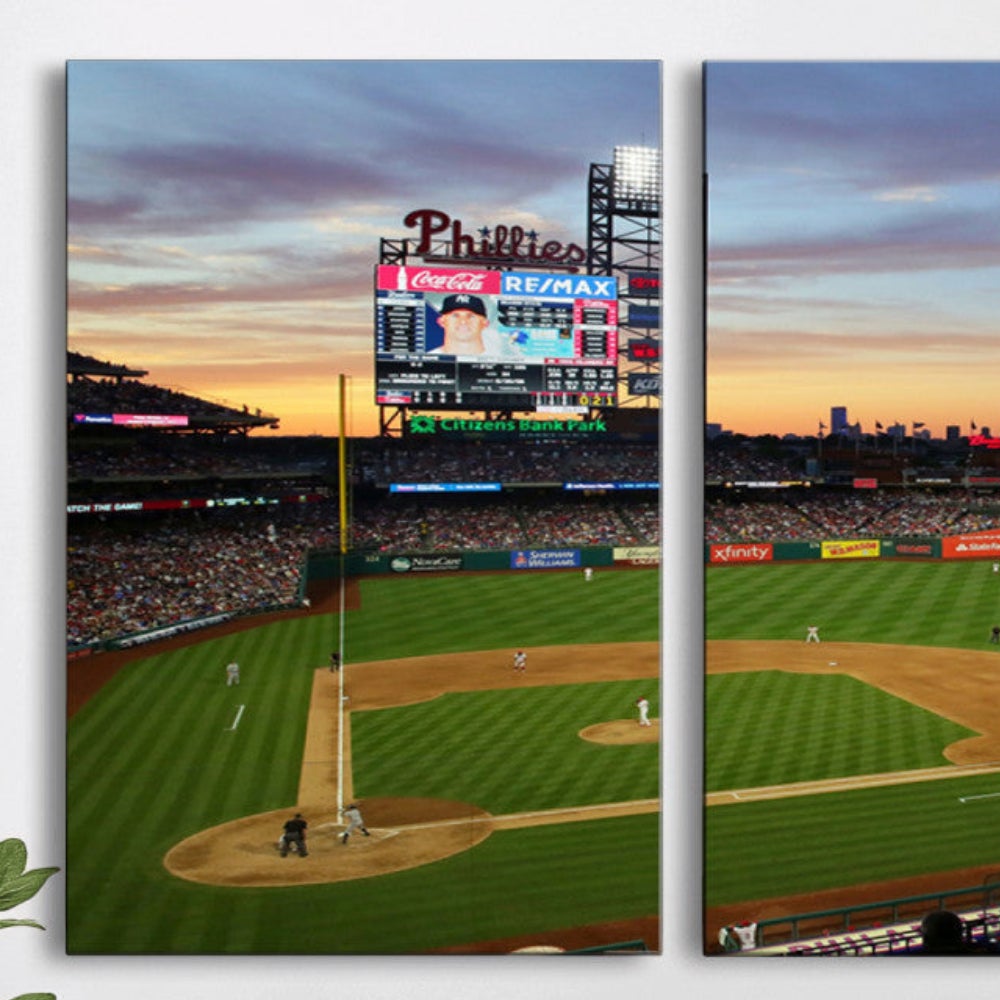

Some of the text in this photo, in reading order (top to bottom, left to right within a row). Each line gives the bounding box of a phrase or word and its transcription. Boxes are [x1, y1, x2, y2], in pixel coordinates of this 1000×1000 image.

[404, 209, 586, 262] Phillies
[505, 276, 610, 296] RE/MAX
[439, 418, 607, 432] Citizens Bank Park
[714, 545, 769, 561] xfinity
